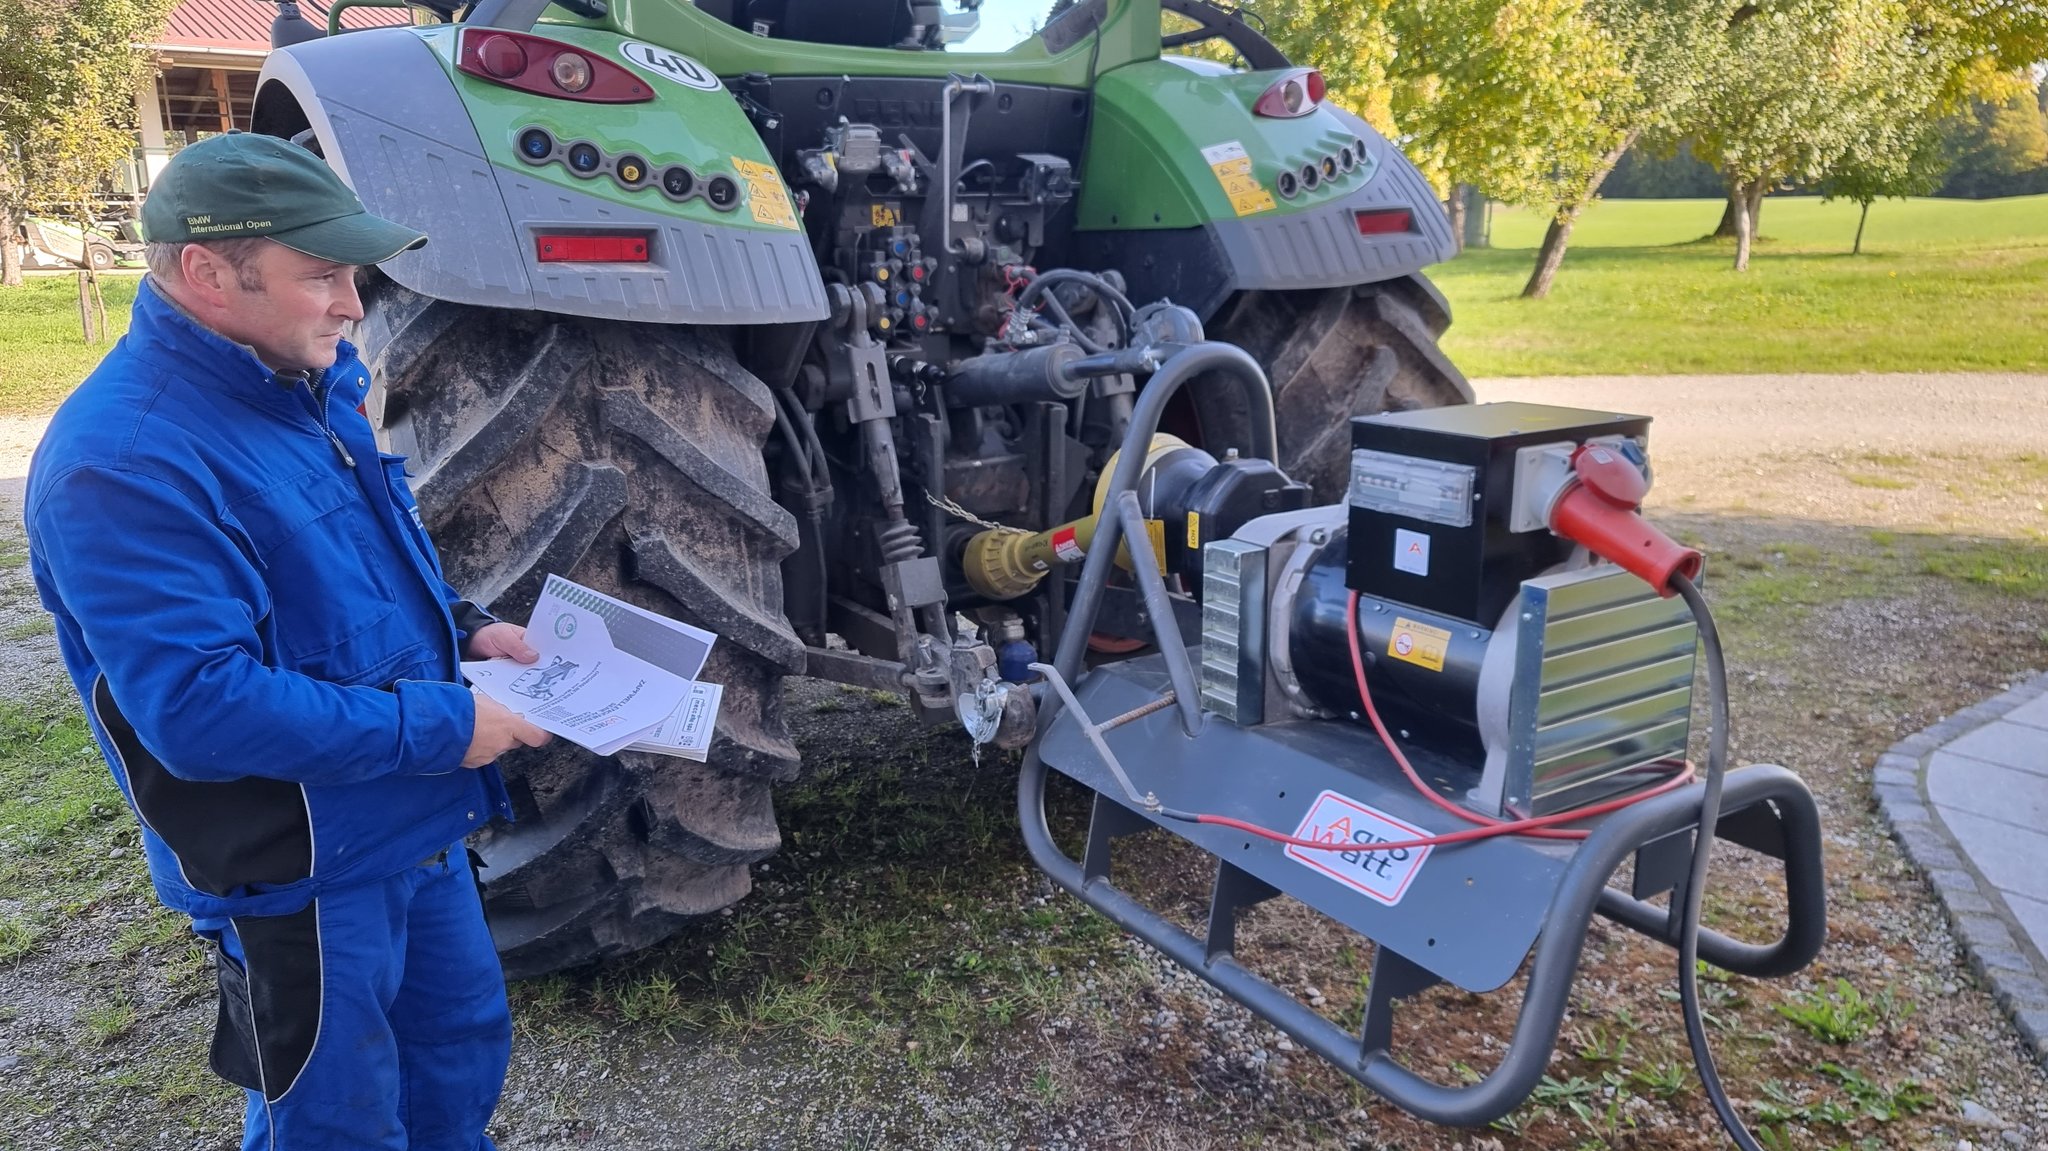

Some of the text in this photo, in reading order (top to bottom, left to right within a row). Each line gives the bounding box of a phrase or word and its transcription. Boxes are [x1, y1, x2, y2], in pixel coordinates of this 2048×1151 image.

[644, 47, 706, 83] 40
[187, 215, 211, 225] BMW
[190, 220, 272, 234] International Open
[1312, 824, 1392, 878] Watt
